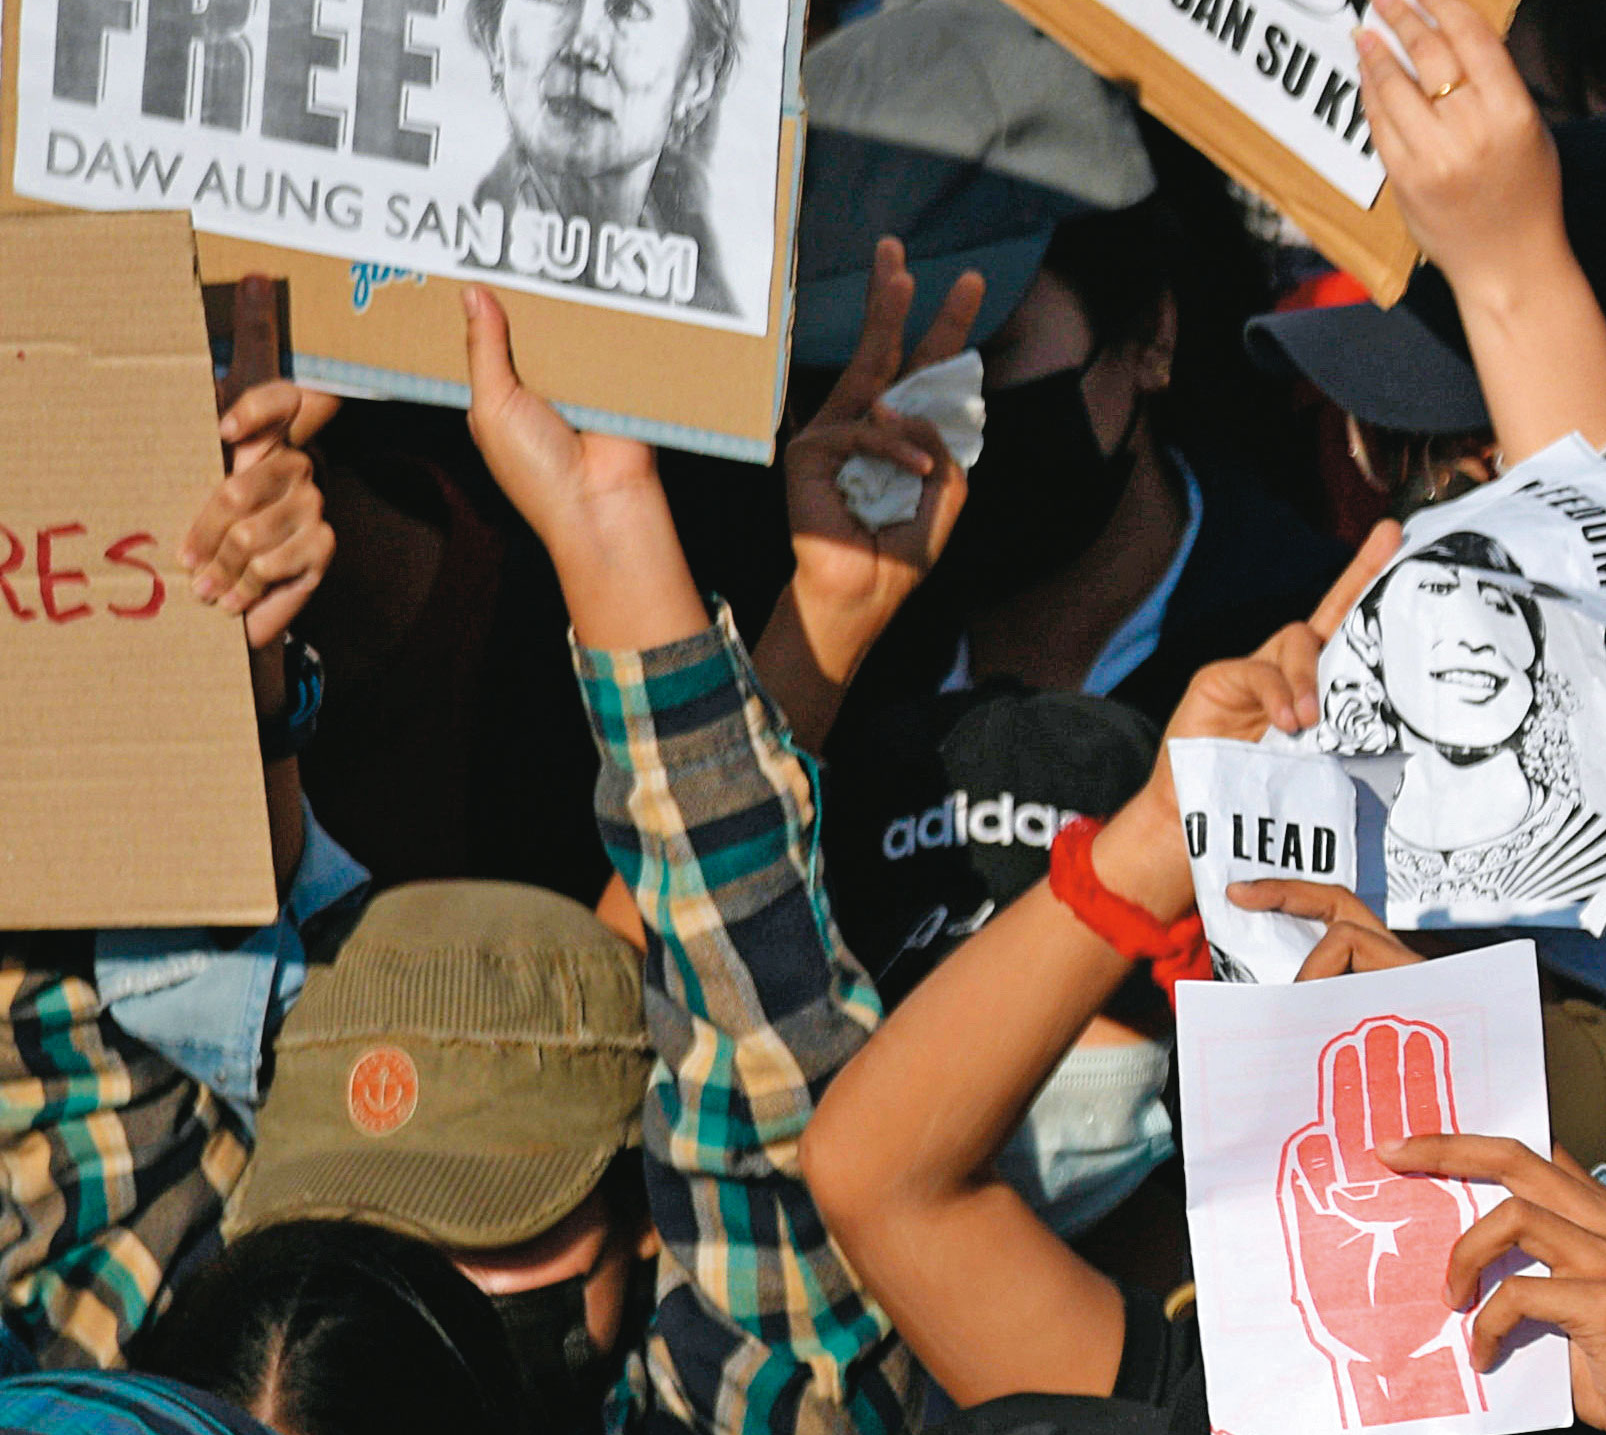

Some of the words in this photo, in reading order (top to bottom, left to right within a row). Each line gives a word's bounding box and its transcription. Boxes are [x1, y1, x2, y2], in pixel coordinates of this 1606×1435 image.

[1257, 24, 1320, 111] SU
[46, 131, 183, 196] DAW
[193, 161, 364, 231] AUNG
[383, 194, 503, 266] SAN
[508, 212, 591, 280] SU
[596, 229, 700, 302] KYI
[1233, 813, 1336, 874] LEAD
